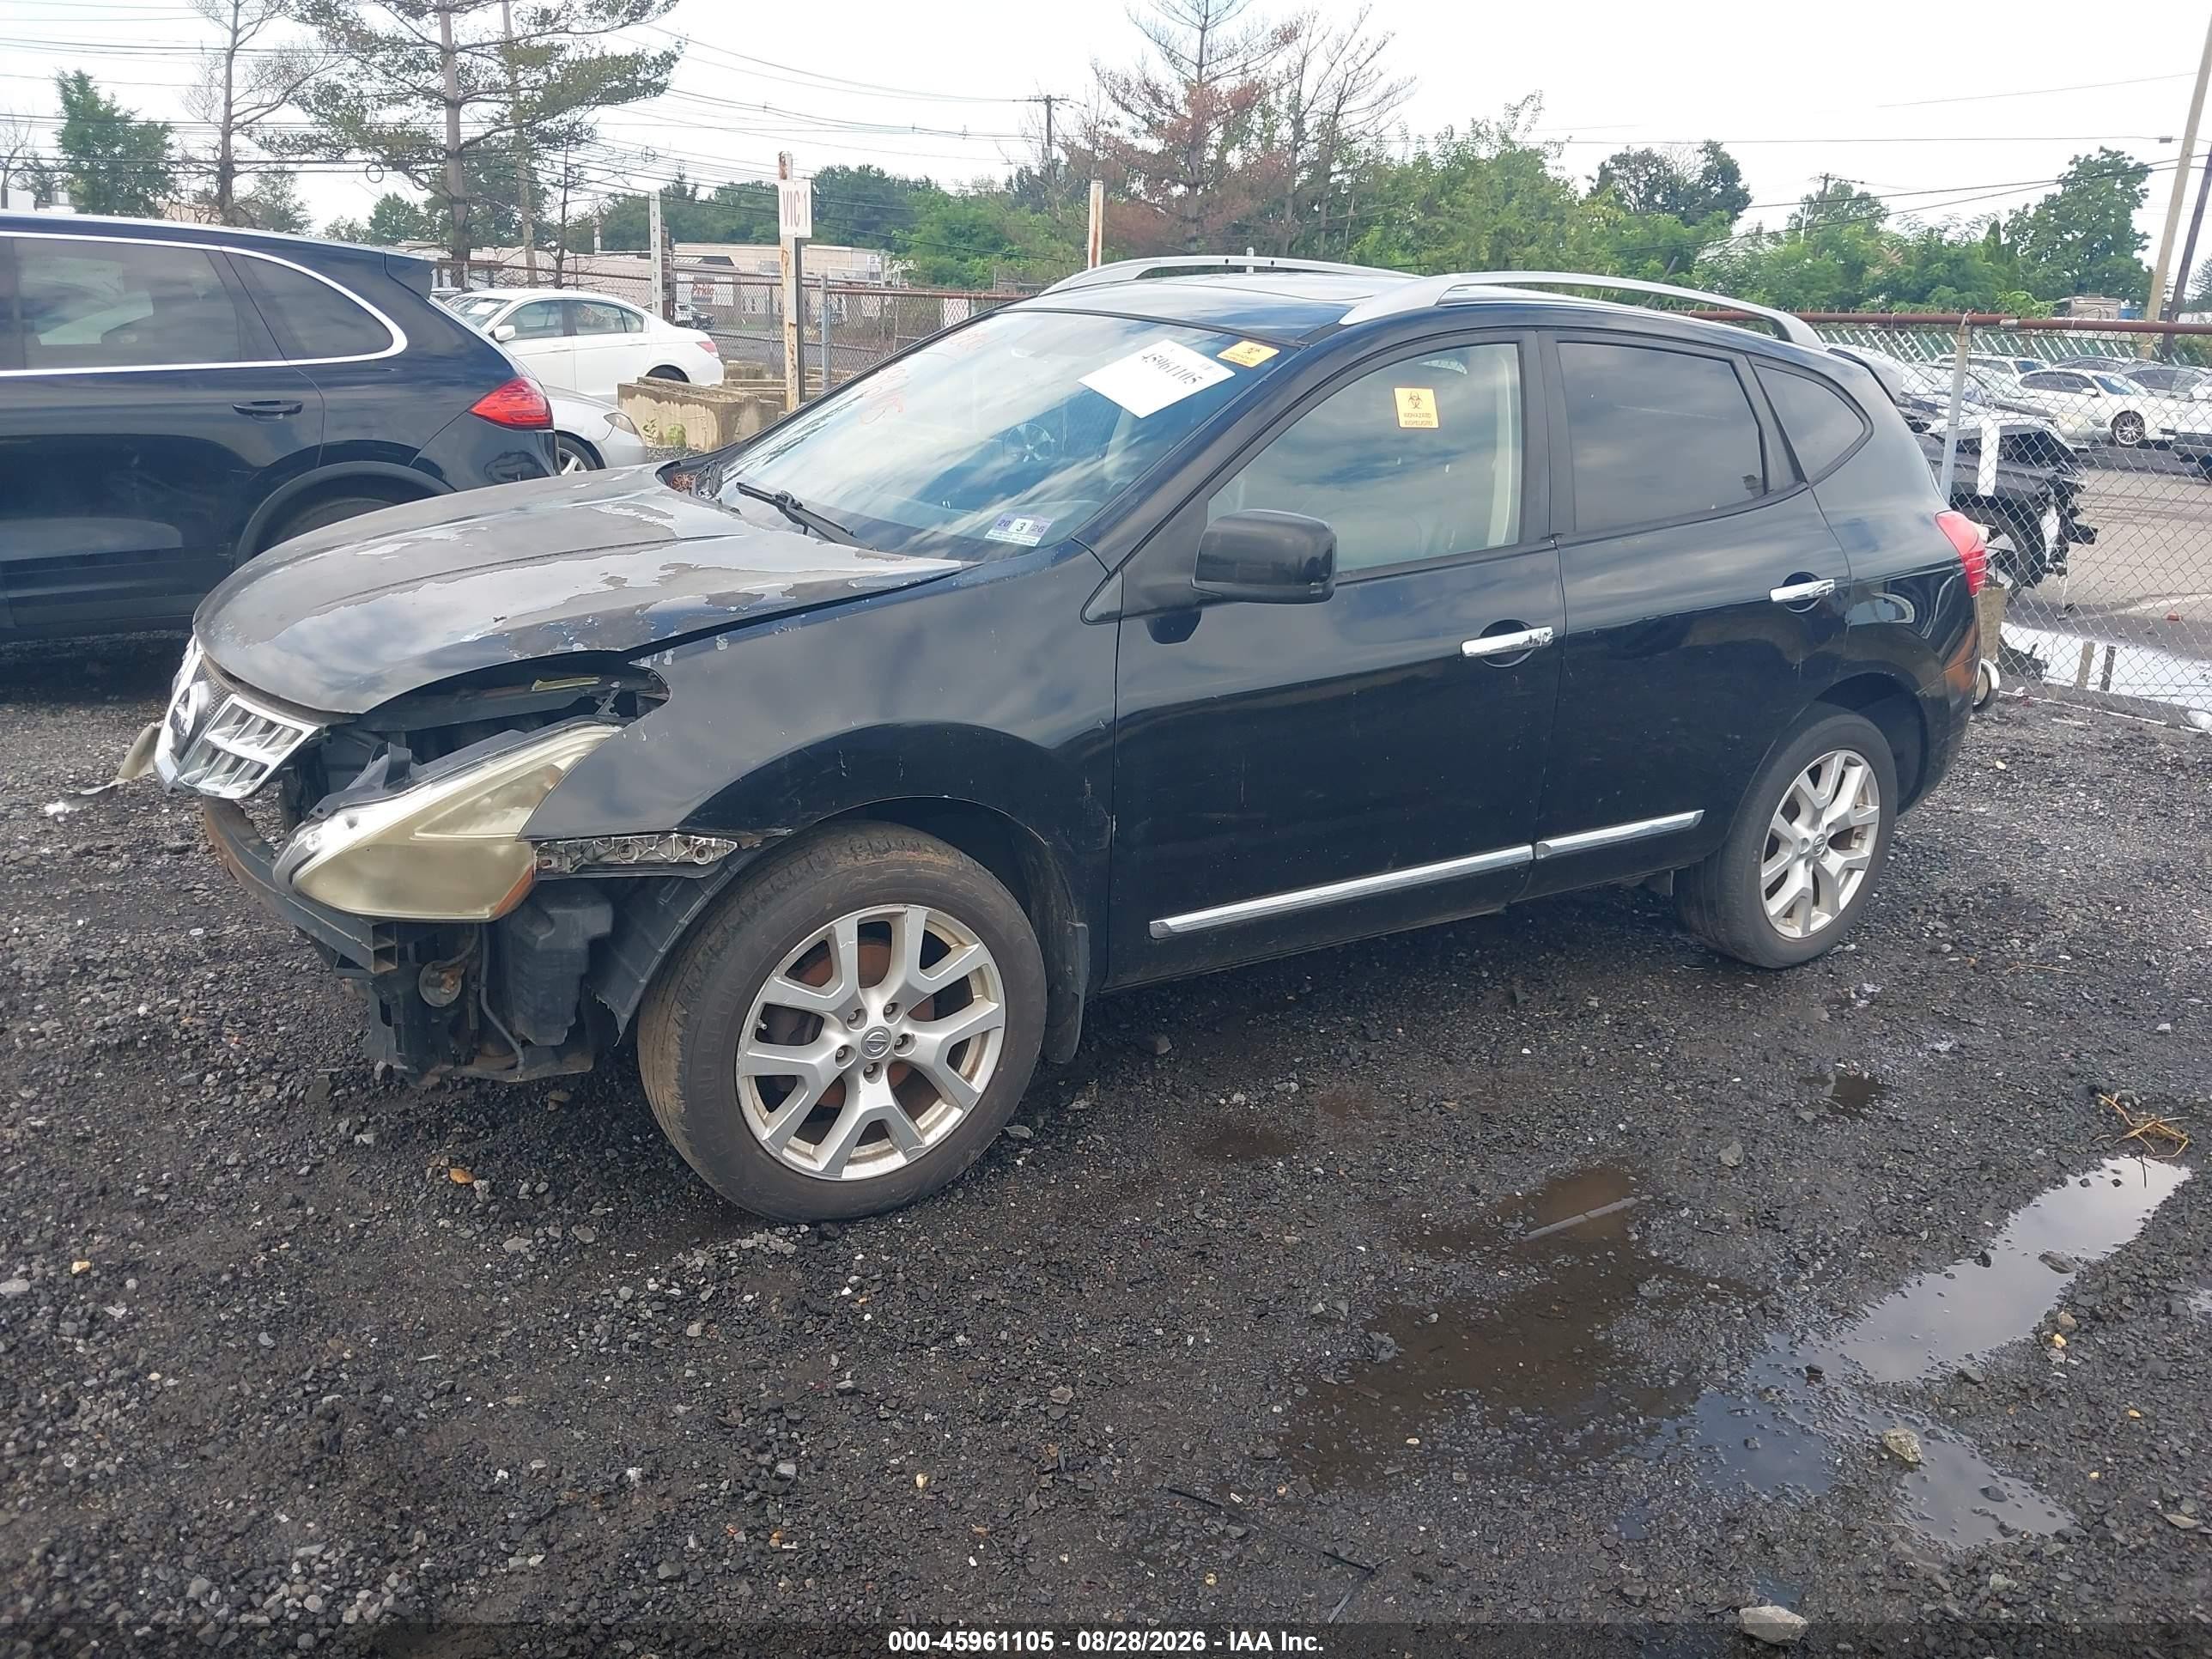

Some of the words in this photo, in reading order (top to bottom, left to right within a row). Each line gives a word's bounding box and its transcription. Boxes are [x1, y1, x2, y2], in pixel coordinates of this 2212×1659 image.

[782, 190, 799, 228] VIC
[1140, 352, 1204, 385] 45961105
[997, 519, 1011, 527] 20
[1016, 522, 1026, 532] 3
[1030, 525, 1045, 533] 26
